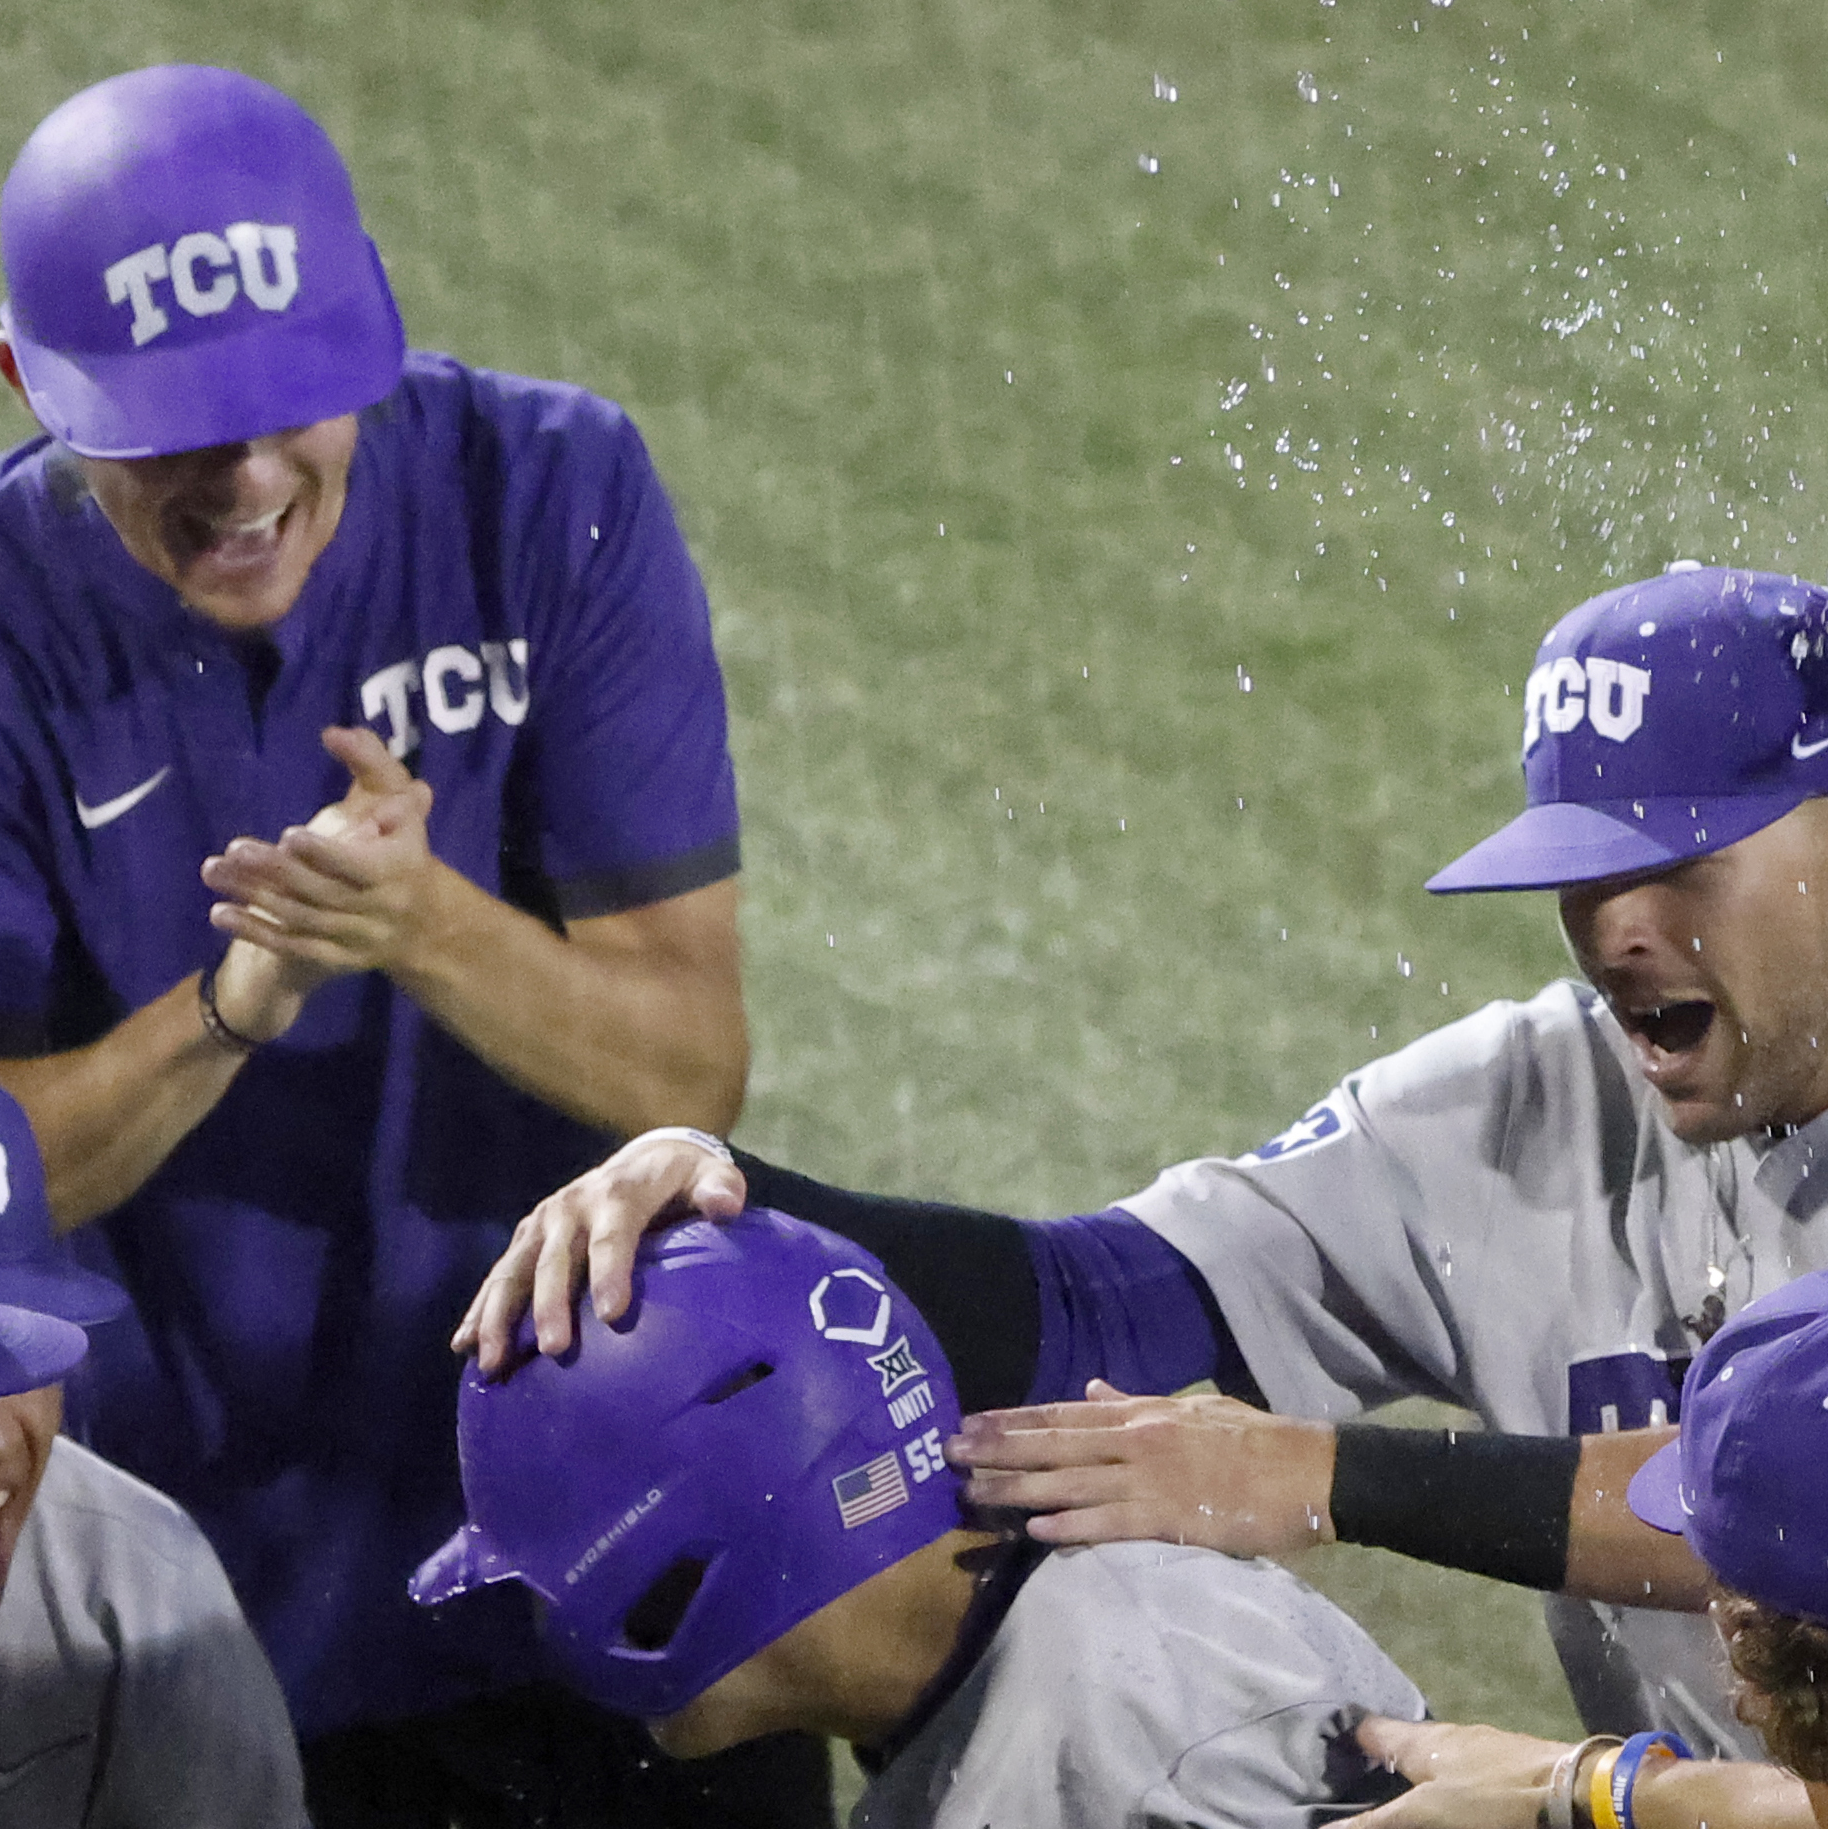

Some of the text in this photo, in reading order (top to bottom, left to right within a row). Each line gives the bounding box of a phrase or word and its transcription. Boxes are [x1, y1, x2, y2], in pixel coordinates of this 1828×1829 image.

[104, 221, 299, 347] TCU
[361, 638, 530, 759] TCU
[887, 1381, 935, 1429] UNITY
[905, 1427, 946, 1483] 55
